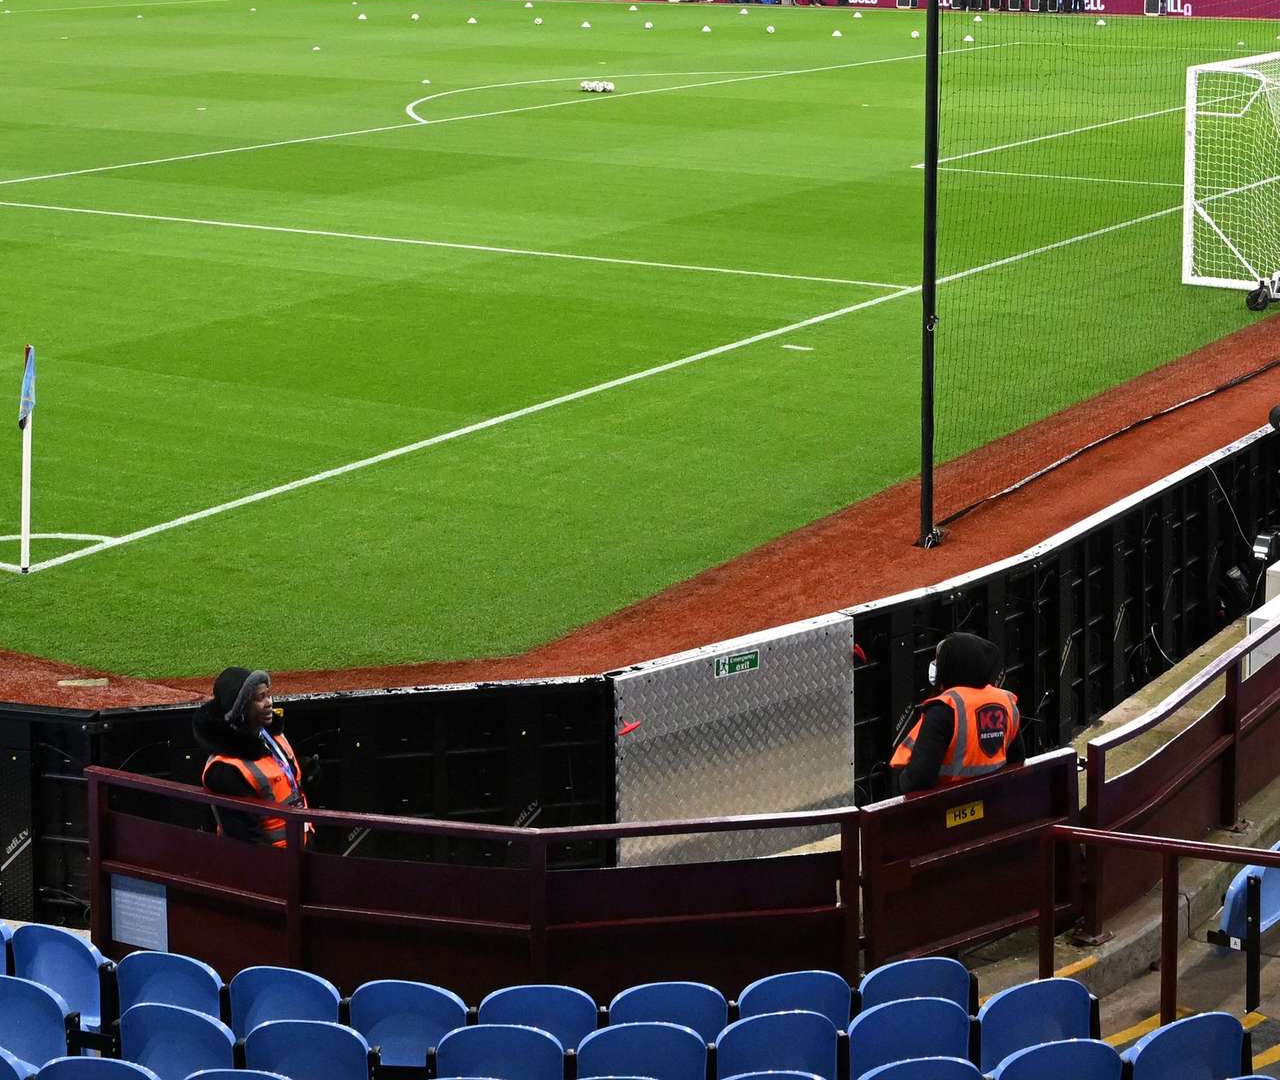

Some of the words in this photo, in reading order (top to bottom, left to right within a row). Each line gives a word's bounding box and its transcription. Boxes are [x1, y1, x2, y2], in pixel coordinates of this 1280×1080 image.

[735, 661, 751, 671] exit
[981, 710, 1004, 730] K2
[953, 808, 968, 822] HS
[970, 806, 977, 817] 6
[5, 829, 30, 855] adi.tv
